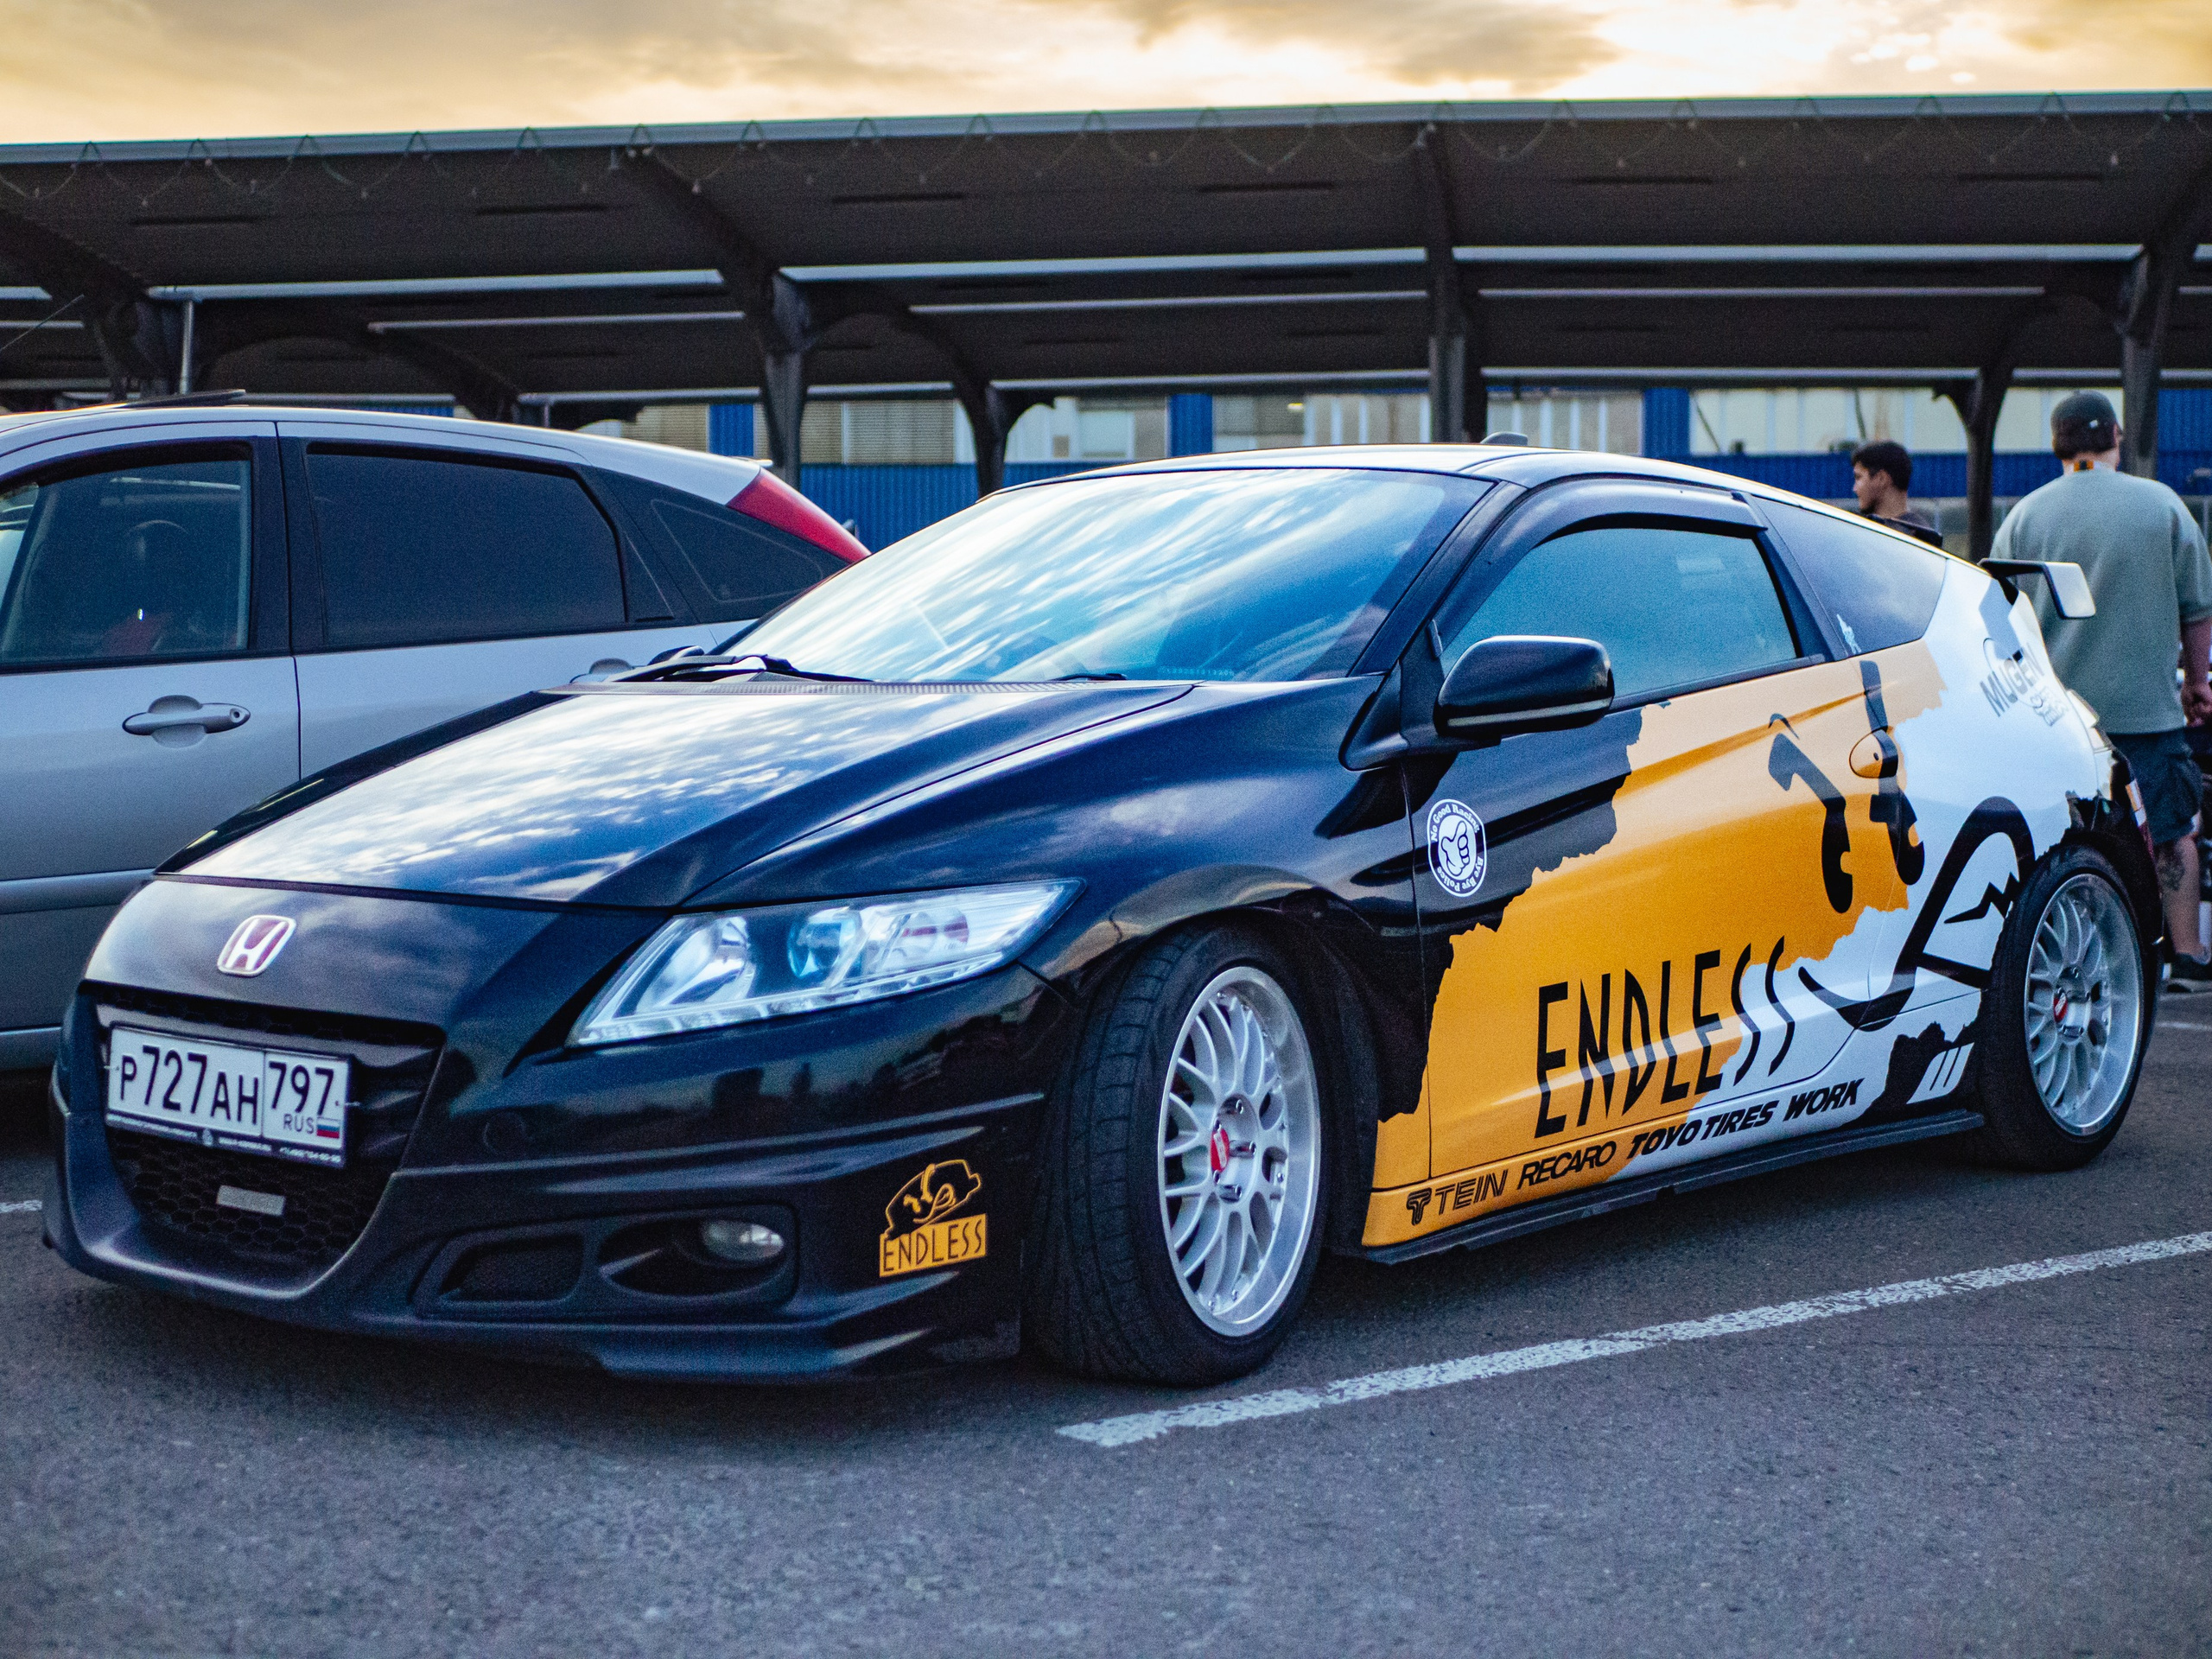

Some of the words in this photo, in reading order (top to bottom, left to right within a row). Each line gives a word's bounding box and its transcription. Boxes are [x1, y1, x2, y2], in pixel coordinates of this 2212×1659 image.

[1980, 642, 2044, 717] MUGEN
[1430, 824, 1439, 842] No
[1433, 804, 1452, 823] Good
[1452, 804, 1480, 833] Racing
[1437, 866, 1460, 892] Police
[1461, 876, 1477, 890] Bye
[1474, 856, 1484, 877] Bye
[1535, 936, 1795, 1139] ENDLESS
[119, 1044, 259, 1125] P727AH
[268, 1060, 334, 1116] 797
[1783, 1077, 1866, 1122] WORK
[283, 1113, 315, 1135] RUS
[1626, 1118, 1702, 1160] TOYO
[1700, 1100, 1780, 1141] TIRES
[1516, 1141, 1617, 1190] RECARO
[1434, 1169, 1509, 1215] TEIN
[883, 1219, 982, 1272] ENDLESS
